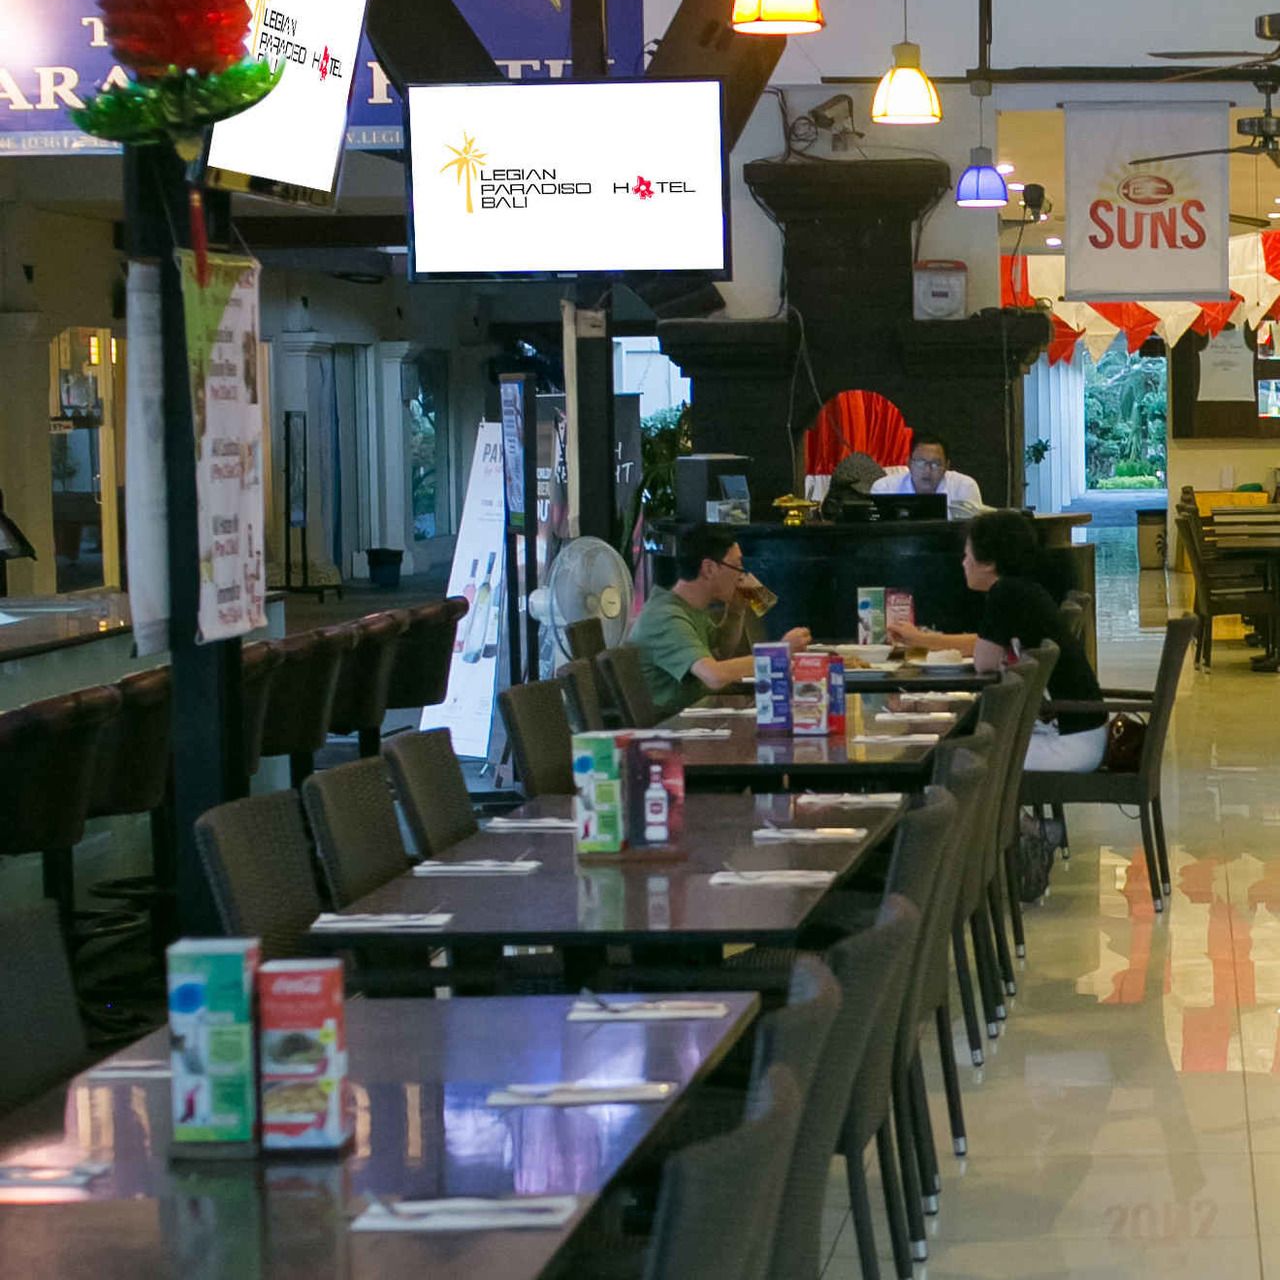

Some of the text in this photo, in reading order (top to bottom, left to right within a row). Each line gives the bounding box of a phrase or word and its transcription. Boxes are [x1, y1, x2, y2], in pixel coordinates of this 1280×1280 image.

[480, 169, 556, 181] LEGIAN
[481, 183, 592, 195] PARADISO
[481, 197, 528, 209] BALI
[1088, 199, 1206, 250] SUNS
